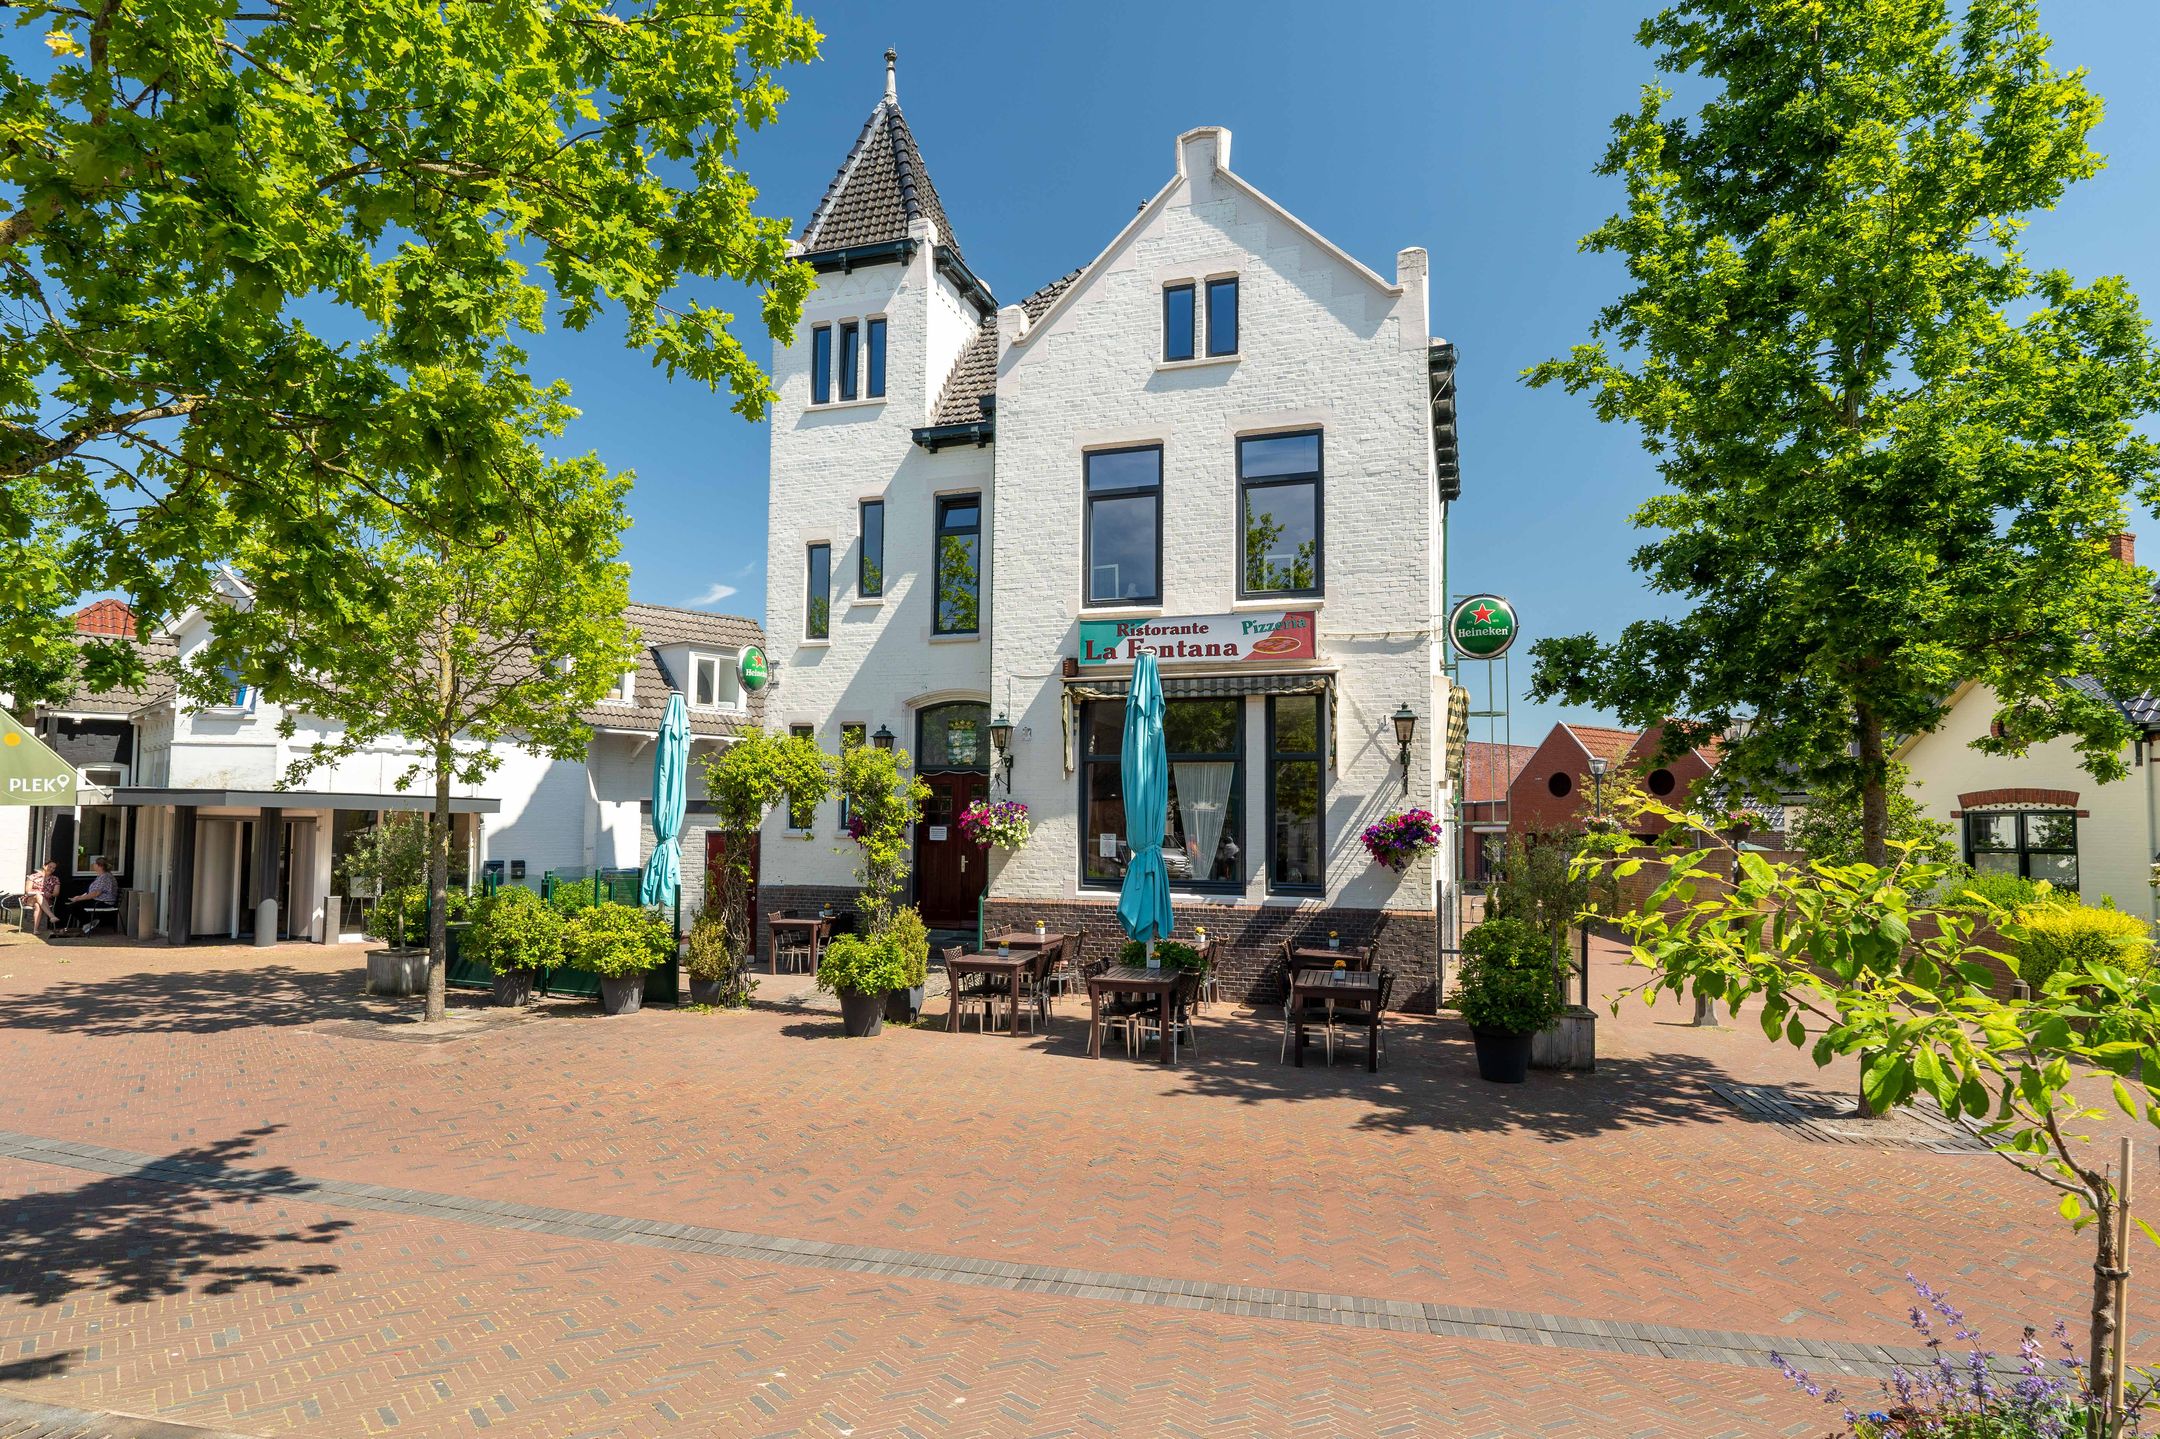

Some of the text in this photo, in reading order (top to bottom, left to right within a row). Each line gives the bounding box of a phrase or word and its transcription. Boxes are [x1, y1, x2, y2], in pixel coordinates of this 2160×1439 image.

[1116, 623, 1209, 637] Ristorante
[1241, 615, 1307, 635] Pizzeria
[1458, 627, 1508, 637] Heineken
[1085, 639, 1118, 660] La
[746, 669, 767, 678] Heine
[9, 778, 56, 792] PLEK
